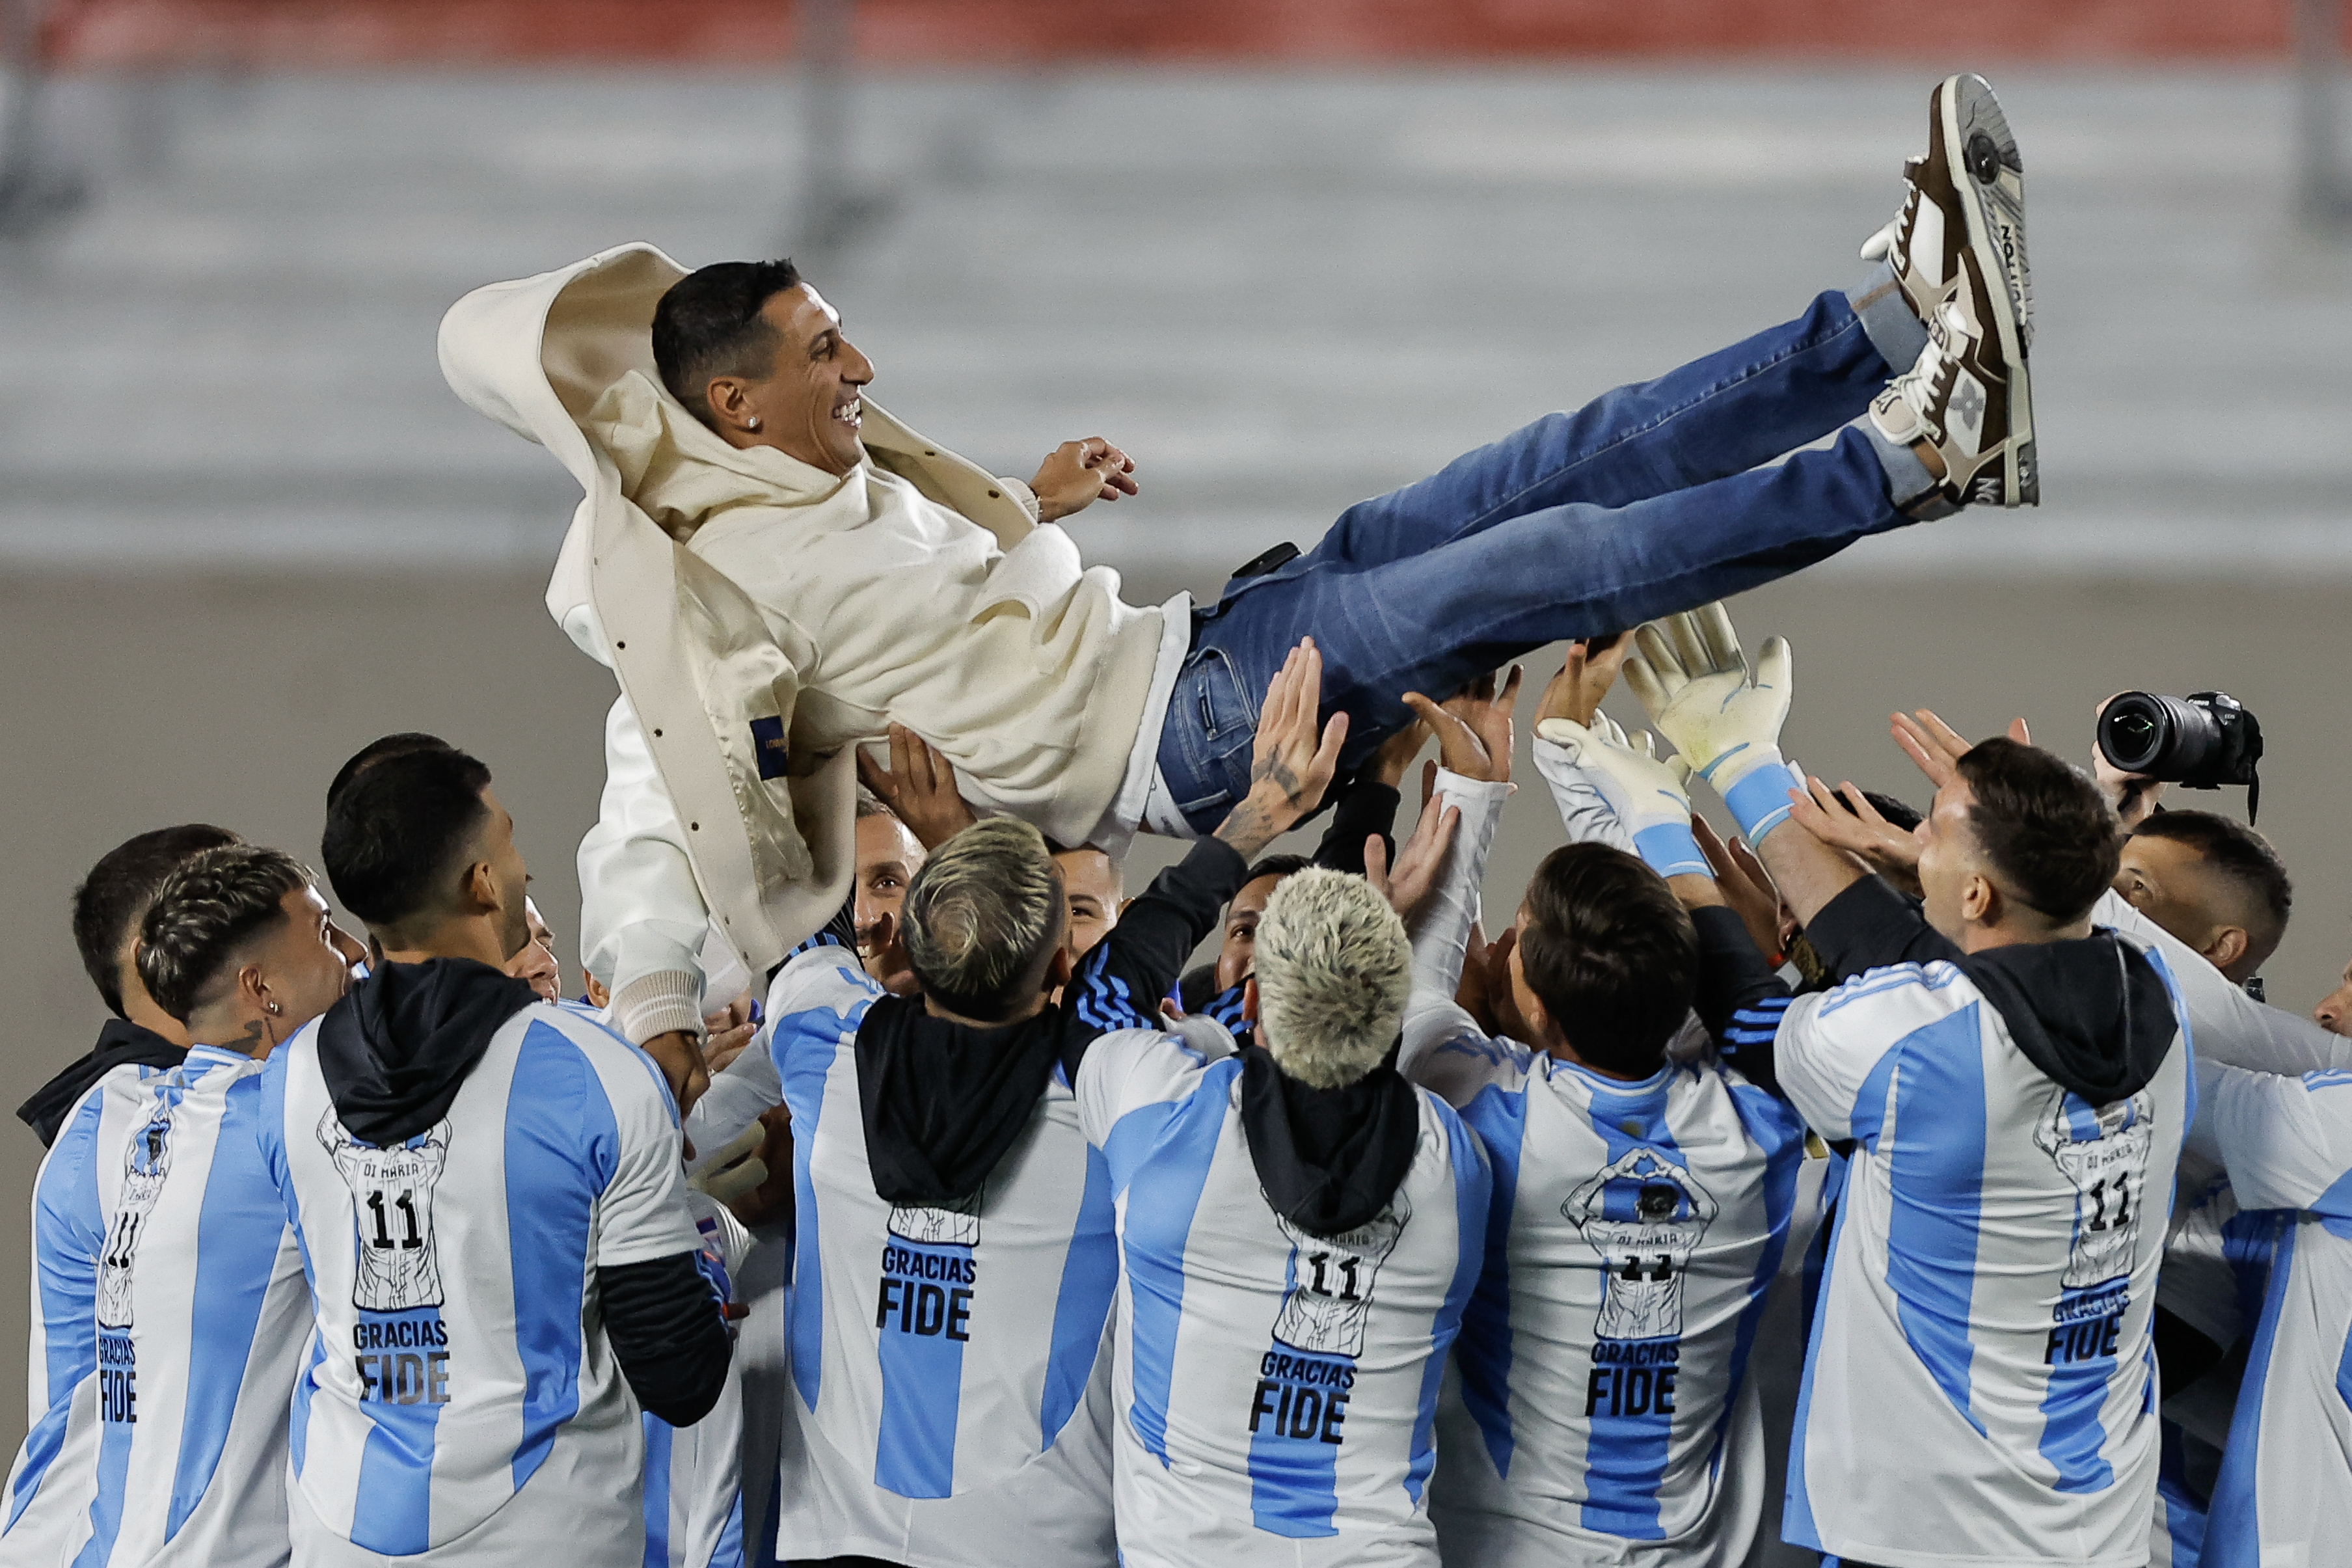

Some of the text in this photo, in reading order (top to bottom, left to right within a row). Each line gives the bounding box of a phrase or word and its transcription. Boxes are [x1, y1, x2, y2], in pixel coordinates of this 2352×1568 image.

[364, 1163, 419, 1179] DI MARIA
[366, 1189, 423, 1249] 11
[2090, 1170, 2129, 1231] 11
[108, 1211, 139, 1269] 11
[882, 1247, 977, 1284] GRACIAS
[1308, 1252, 1360, 1301] 11
[353, 1319, 448, 1349] GRACIAS
[876, 1278, 973, 1342] FIDE
[99, 1338, 136, 1366] GRACIAS
[1261, 1351, 1358, 1390] GRACIAS
[1591, 1342, 1680, 1364] GRACIAS
[100, 1370, 137, 1423] FIDE
[355, 1351, 451, 1405] FIDE
[1585, 1367, 1679, 1416] FIDE
[1249, 1380, 1350, 1445] FIDE
